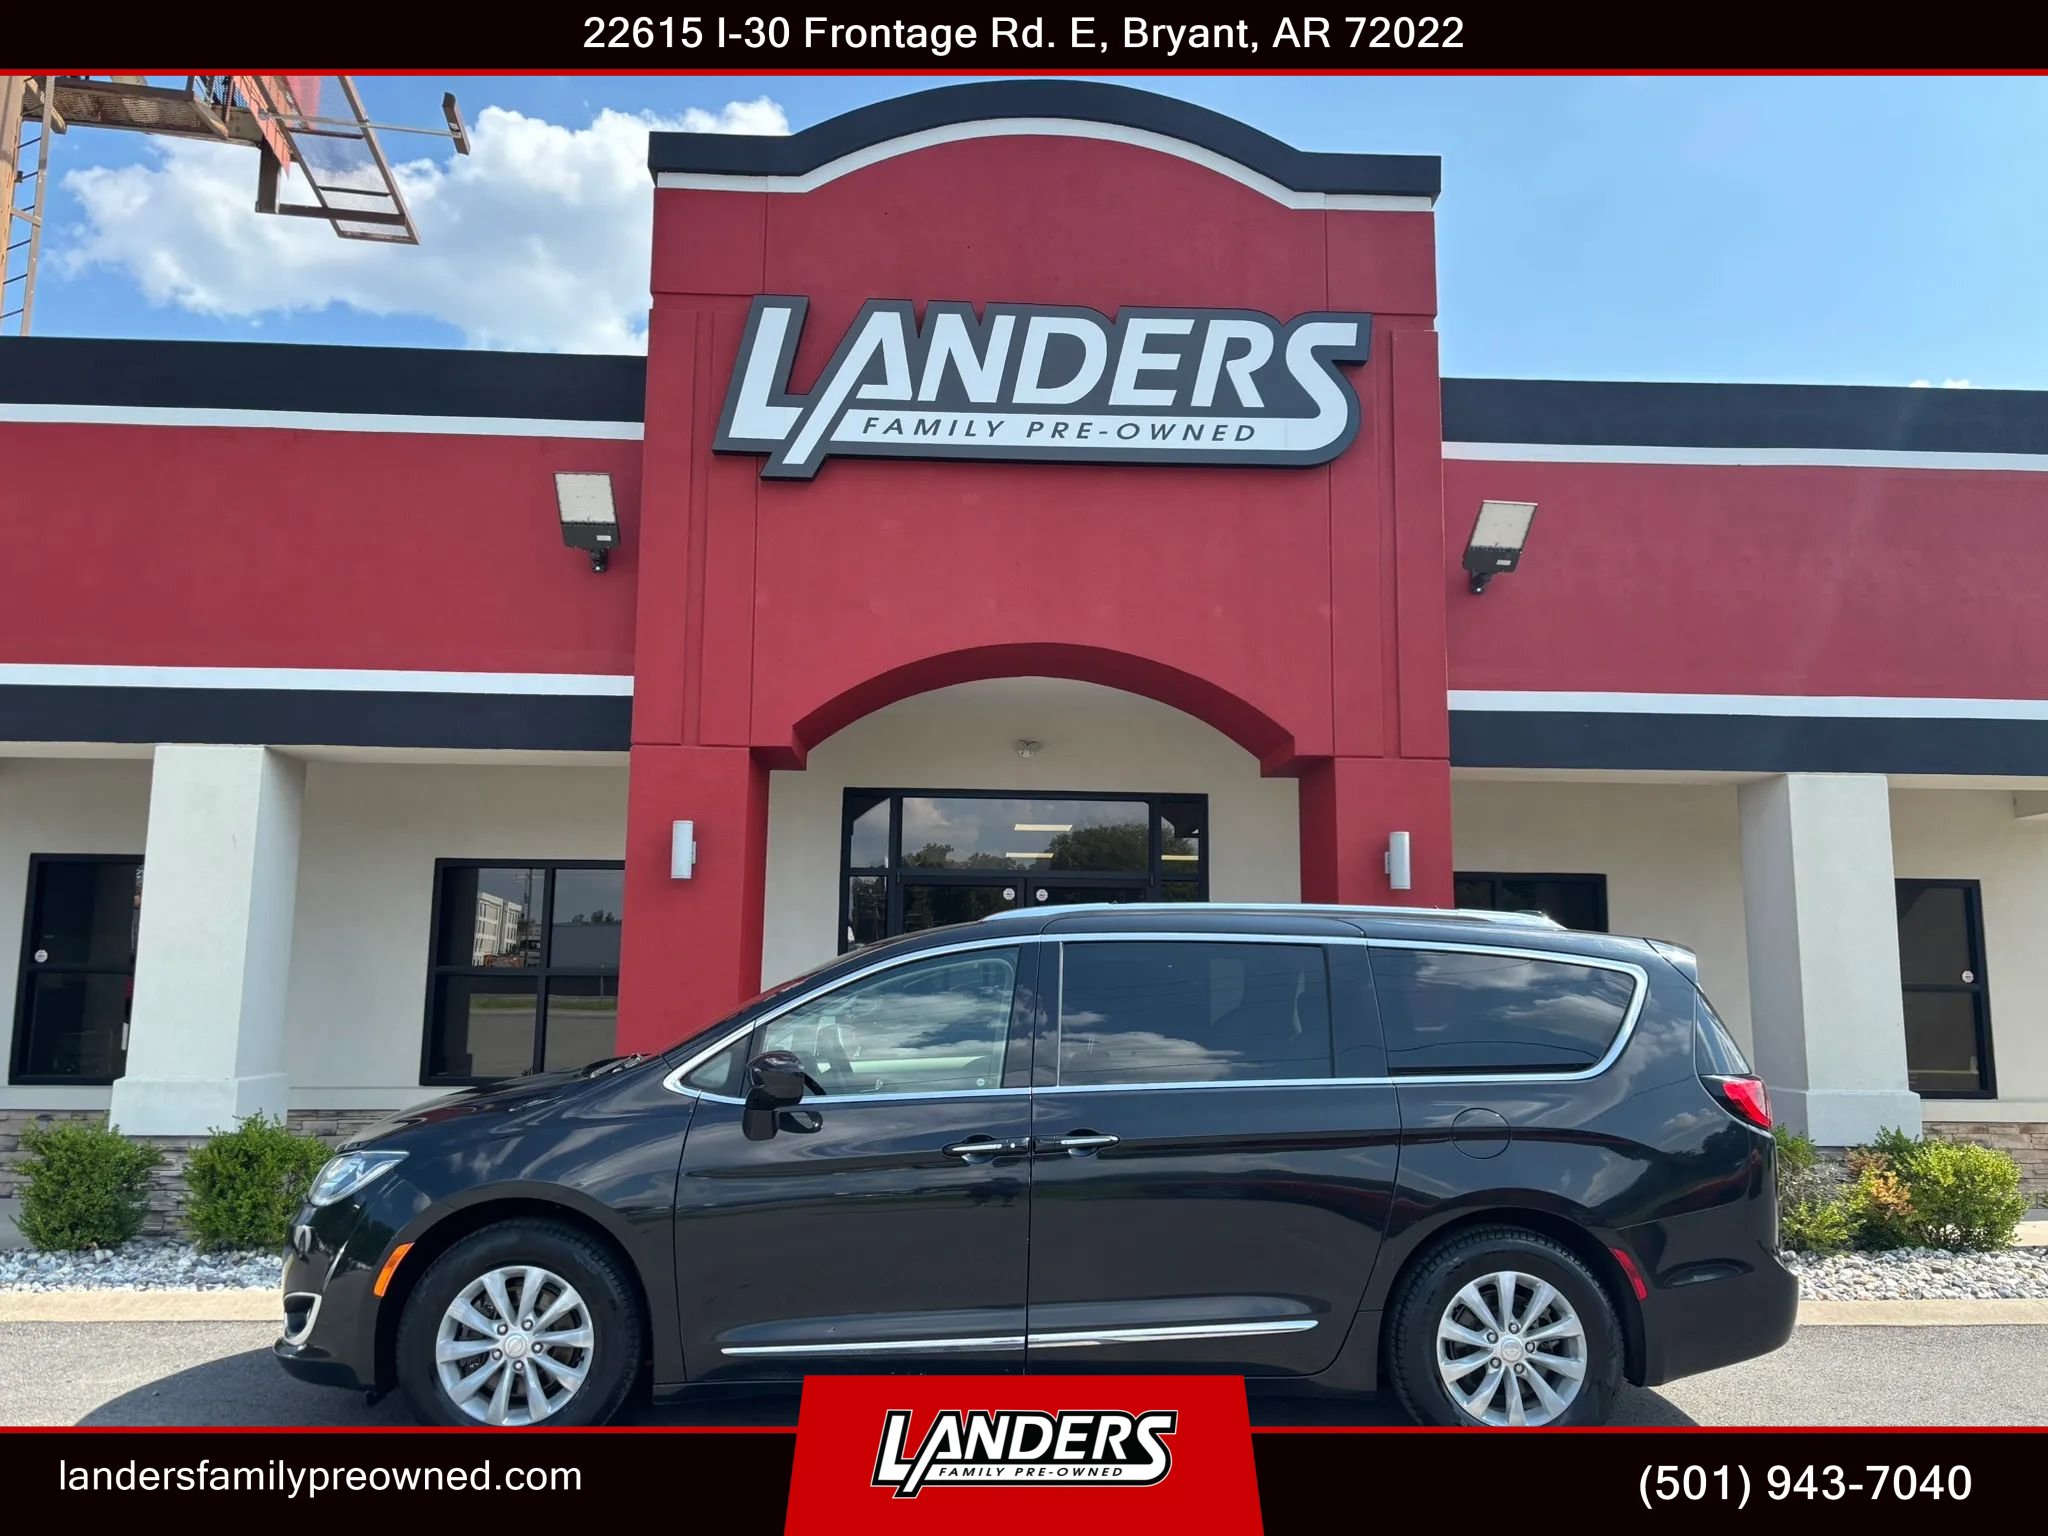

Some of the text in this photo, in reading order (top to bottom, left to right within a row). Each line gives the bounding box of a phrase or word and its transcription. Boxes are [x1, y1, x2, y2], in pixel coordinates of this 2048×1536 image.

[728, 306, 1359, 465] LANDERS
[862, 416, 1257, 444] FAMILY PRE-OWNED
